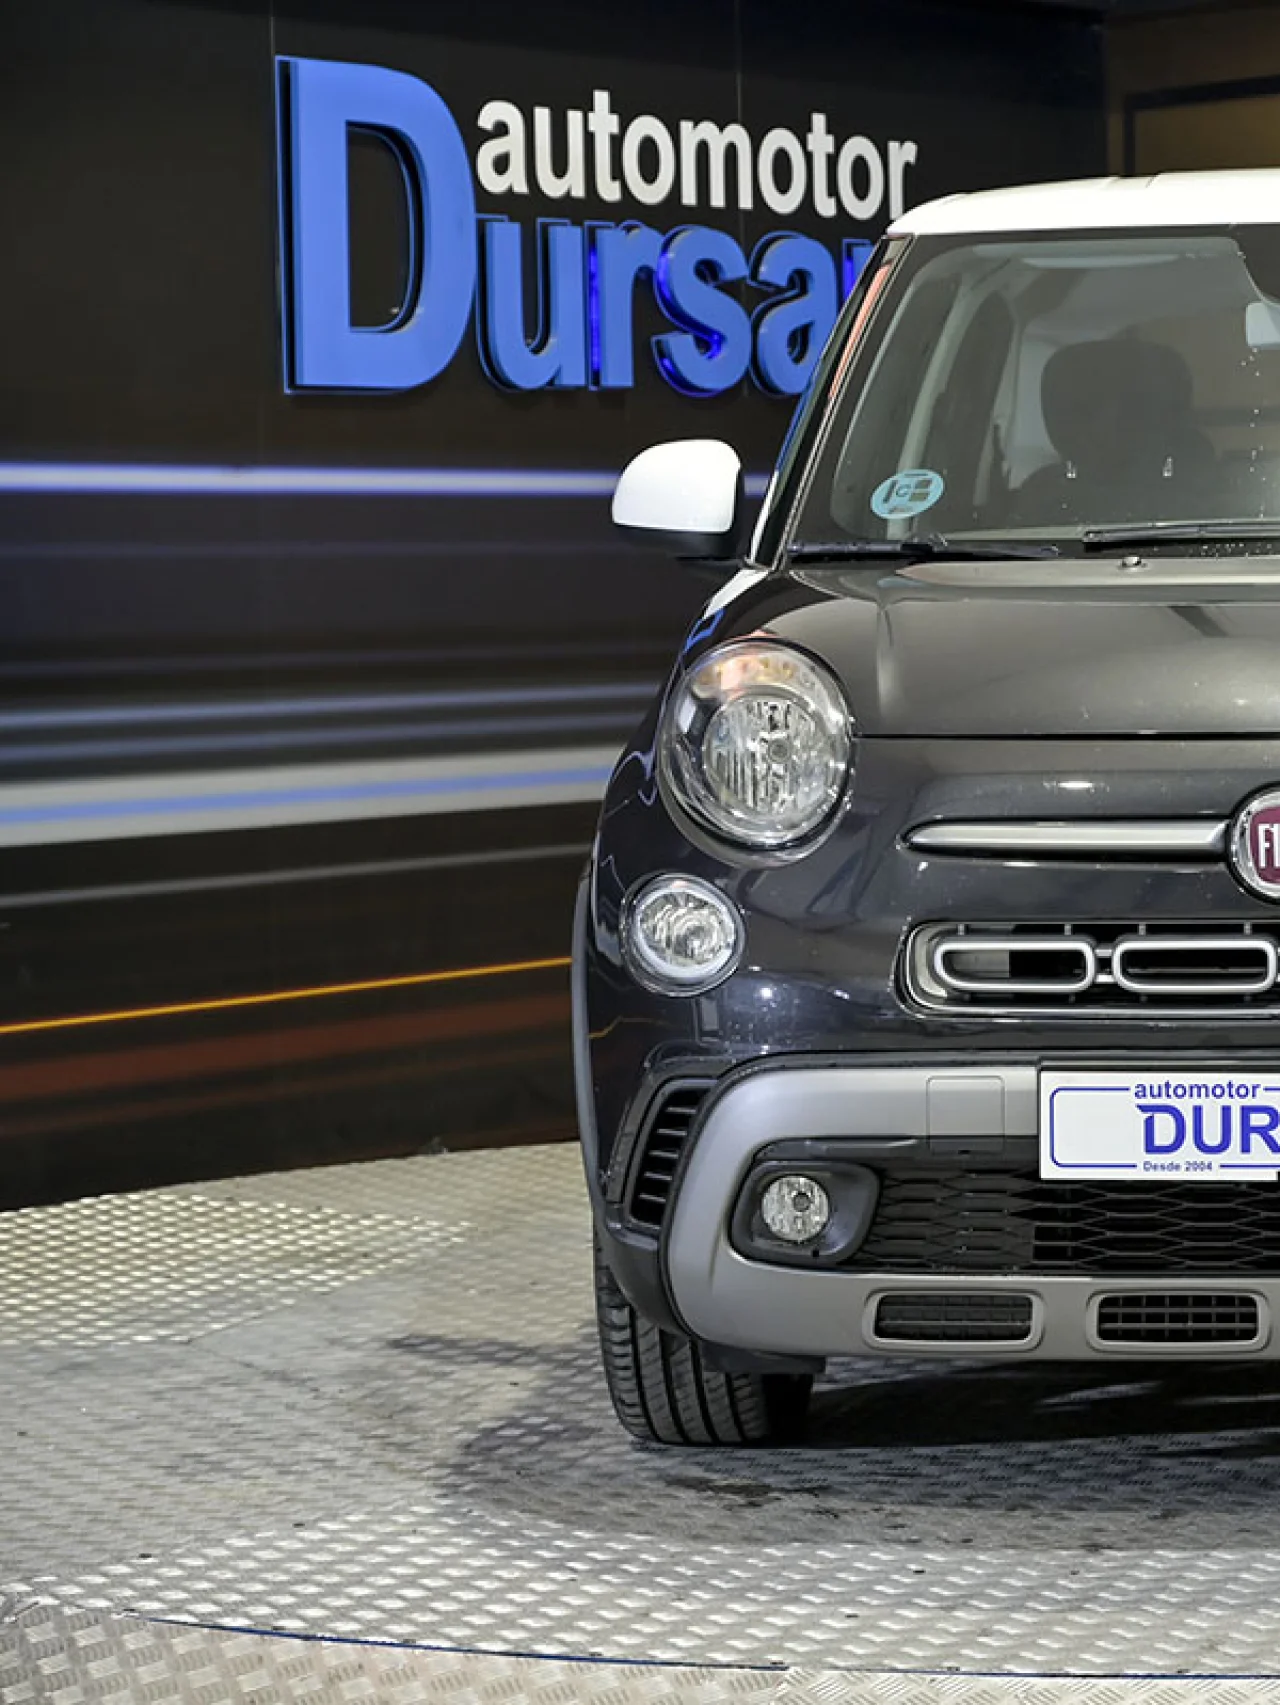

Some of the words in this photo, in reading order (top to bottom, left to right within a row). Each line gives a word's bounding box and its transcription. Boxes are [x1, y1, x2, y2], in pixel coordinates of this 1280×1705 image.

[476, 88, 918, 222] automotor
[275, 54, 874, 396] Dursa
[1133, 1079, 1262, 1100] automotor
[1142, 1160, 1181, 1173] Desde
[1184, 1160, 1213, 1173] 2004
